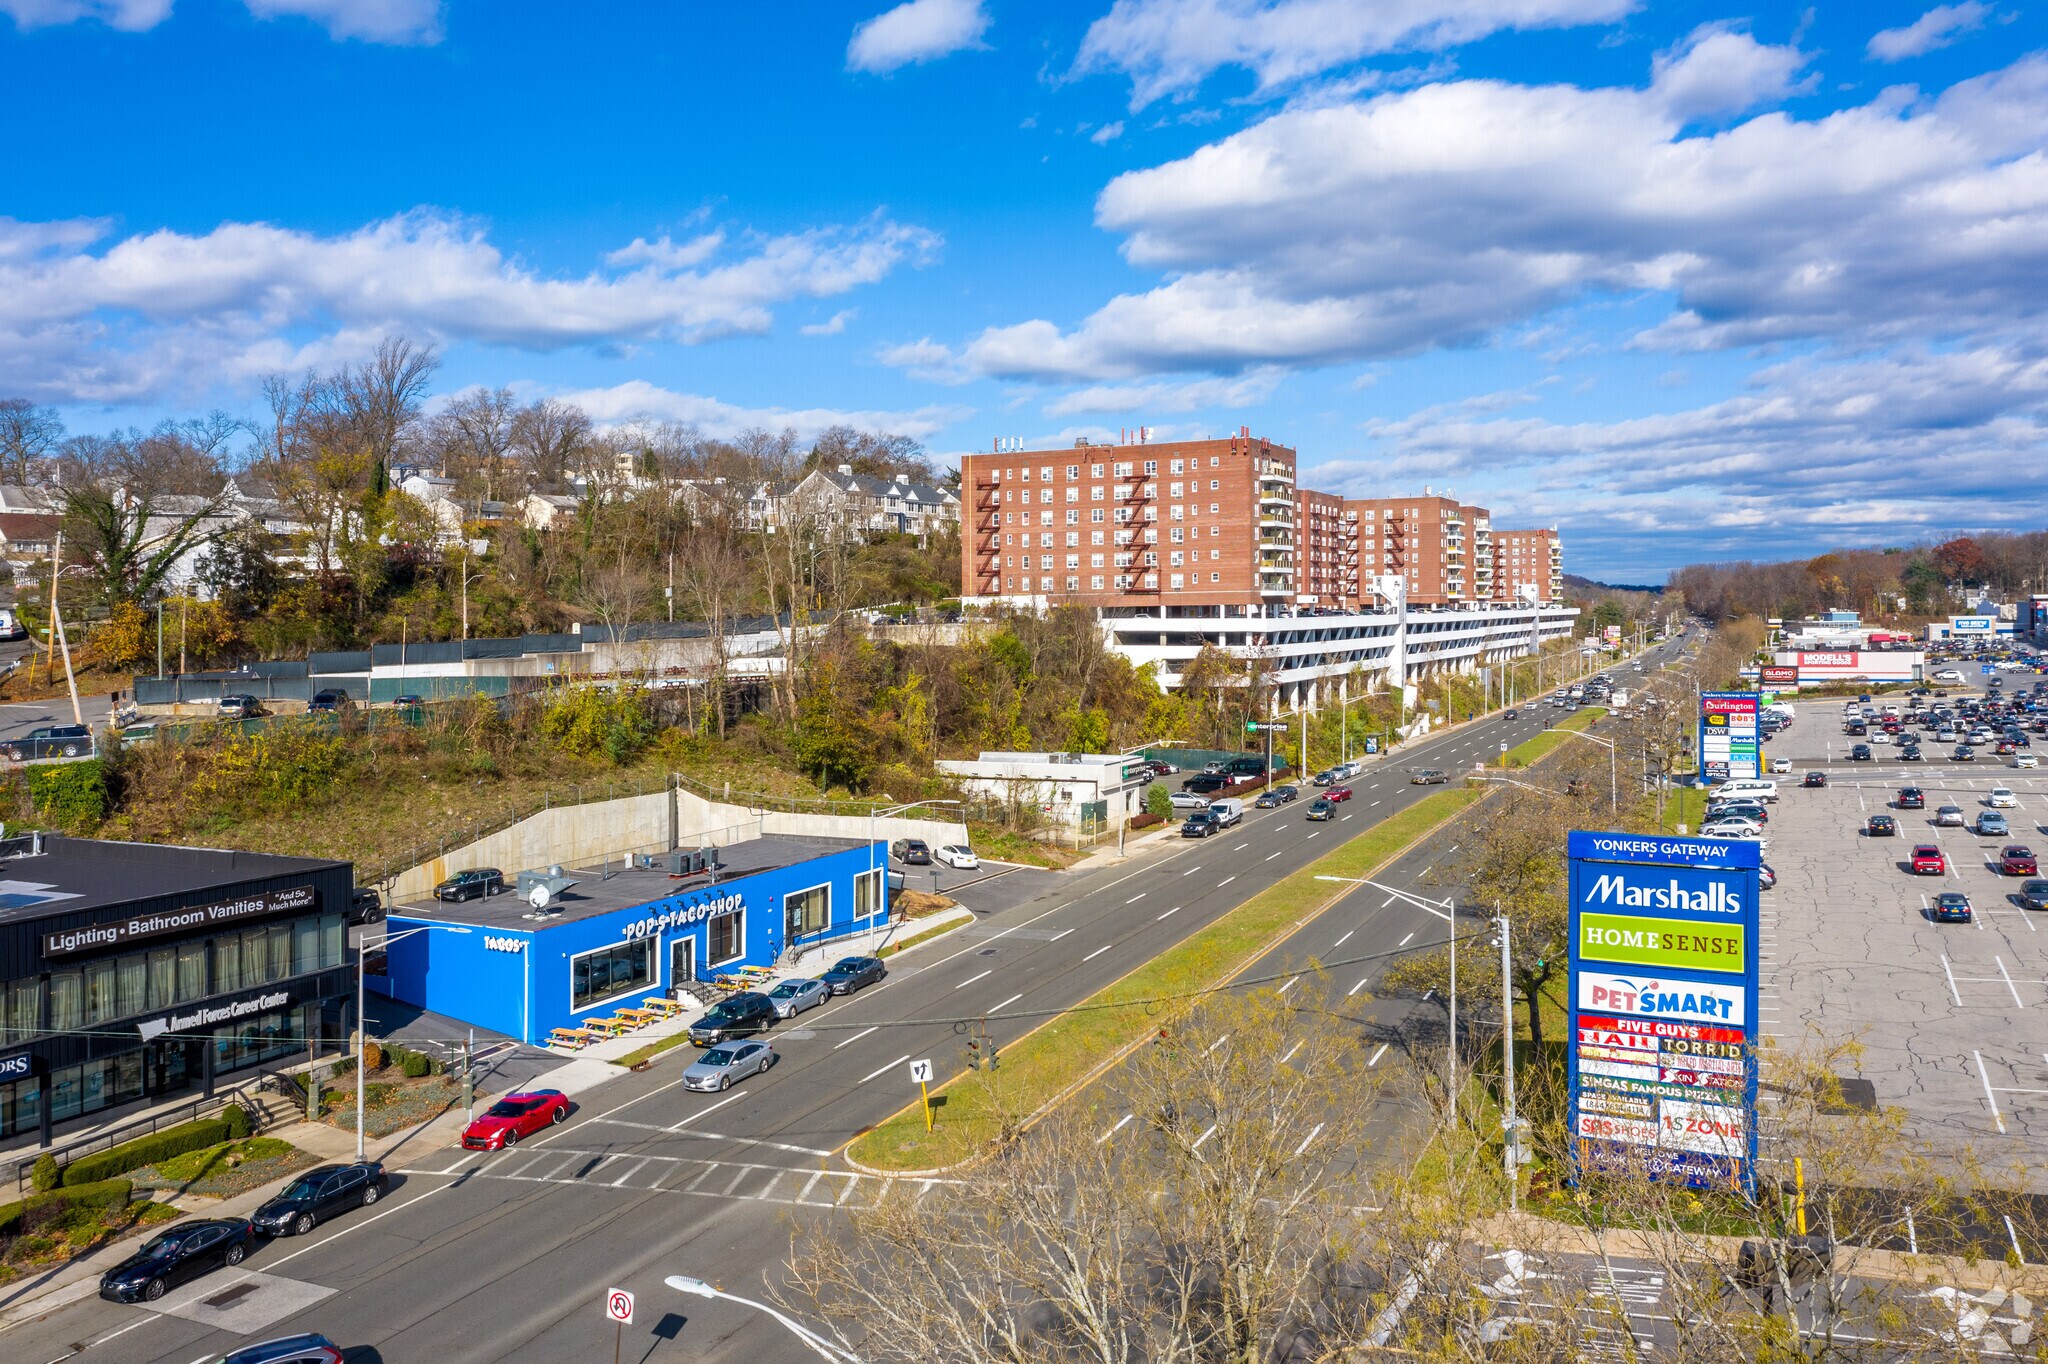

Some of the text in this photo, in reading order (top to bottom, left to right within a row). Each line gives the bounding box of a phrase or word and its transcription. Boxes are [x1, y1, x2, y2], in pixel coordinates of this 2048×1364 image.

[1706, 700, 1754, 712] Burlington
[1592, 839, 1729, 857] YONKERS GATEWAY
[1585, 874, 1741, 914] Marshalls
[268, 901, 289, 911] Much
[669, 903, 706, 928] TACO
[708, 893, 743, 917] SHOP
[50, 900, 264, 951] Lighting Bathroom Vanities
[483, 935, 520, 953] TACOS
[171, 991, 289, 1032] Armed Forces Career Center
[1617, 1019, 1700, 1038] FIVE GUYS
[1664, 1039, 1741, 1058] TORRID
[1581, 1076, 1628, 1092] SINGAS
[1631, 1083, 1682, 1099] FAMOUS
[1684, 1090, 1721, 1102] PIZZA
[1614, 1124, 1656, 1139] SHOES
